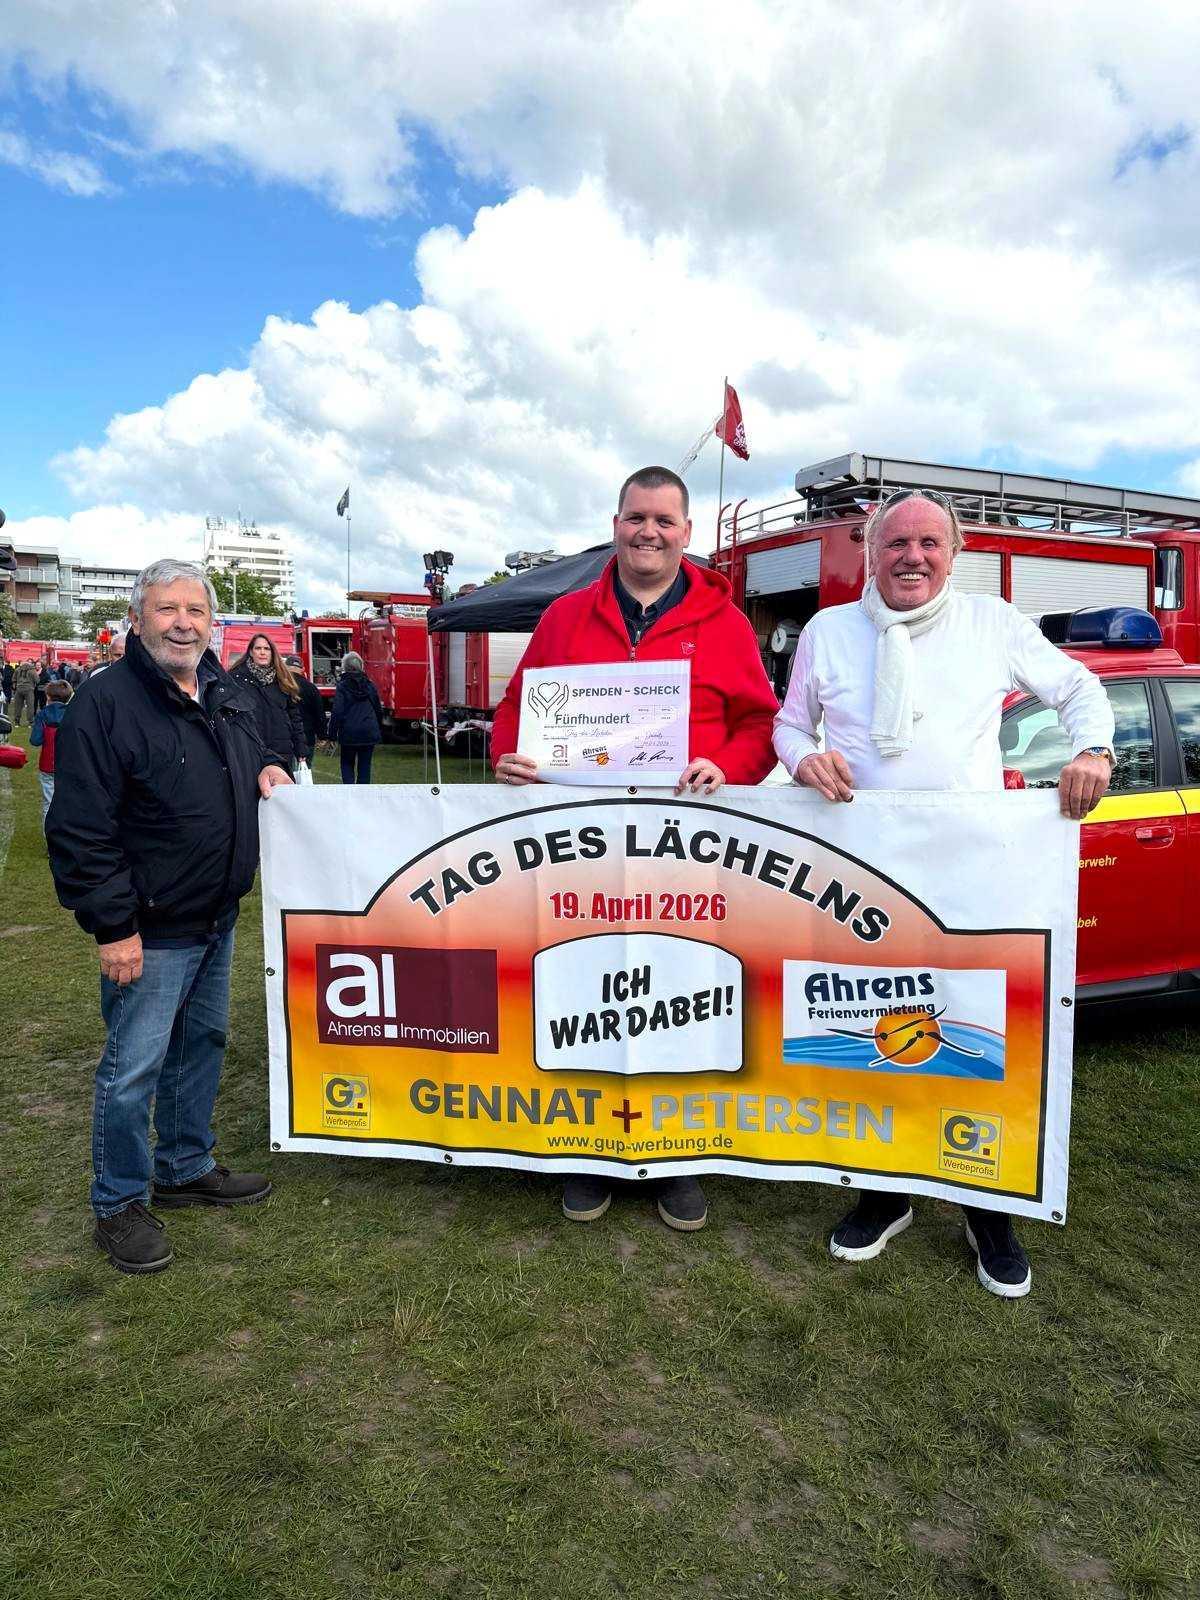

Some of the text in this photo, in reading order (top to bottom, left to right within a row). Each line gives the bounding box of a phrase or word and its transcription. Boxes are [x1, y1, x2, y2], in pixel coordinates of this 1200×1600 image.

[572, 687, 622, 697] SPENDEN
[633, 685, 680, 695] SCHECK
[555, 713, 631, 725] Fünfhundert
[1078, 854, 1117, 869] erwehr
[409, 818, 891, 943] TAG DES LÄCHELNS
[549, 892, 727, 923] 19. April 2026
[1076, 916, 1097, 928] bek
[602, 965, 651, 1004] ICH
[804, 972, 935, 1005] Ahrens
[808, 1004, 936, 1020] Ferienvermietung
[327, 1021, 490, 1045] Ahrens Immobilien
[409, 1078, 602, 1126] GENNAT
[651, 1091, 895, 1144] PETERSEN
[326, 1115, 367, 1127] Werbeprofis
[547, 1133, 734, 1154] www.gup-werbung.de
[943, 1158, 995, 1176] Werbeprofis
